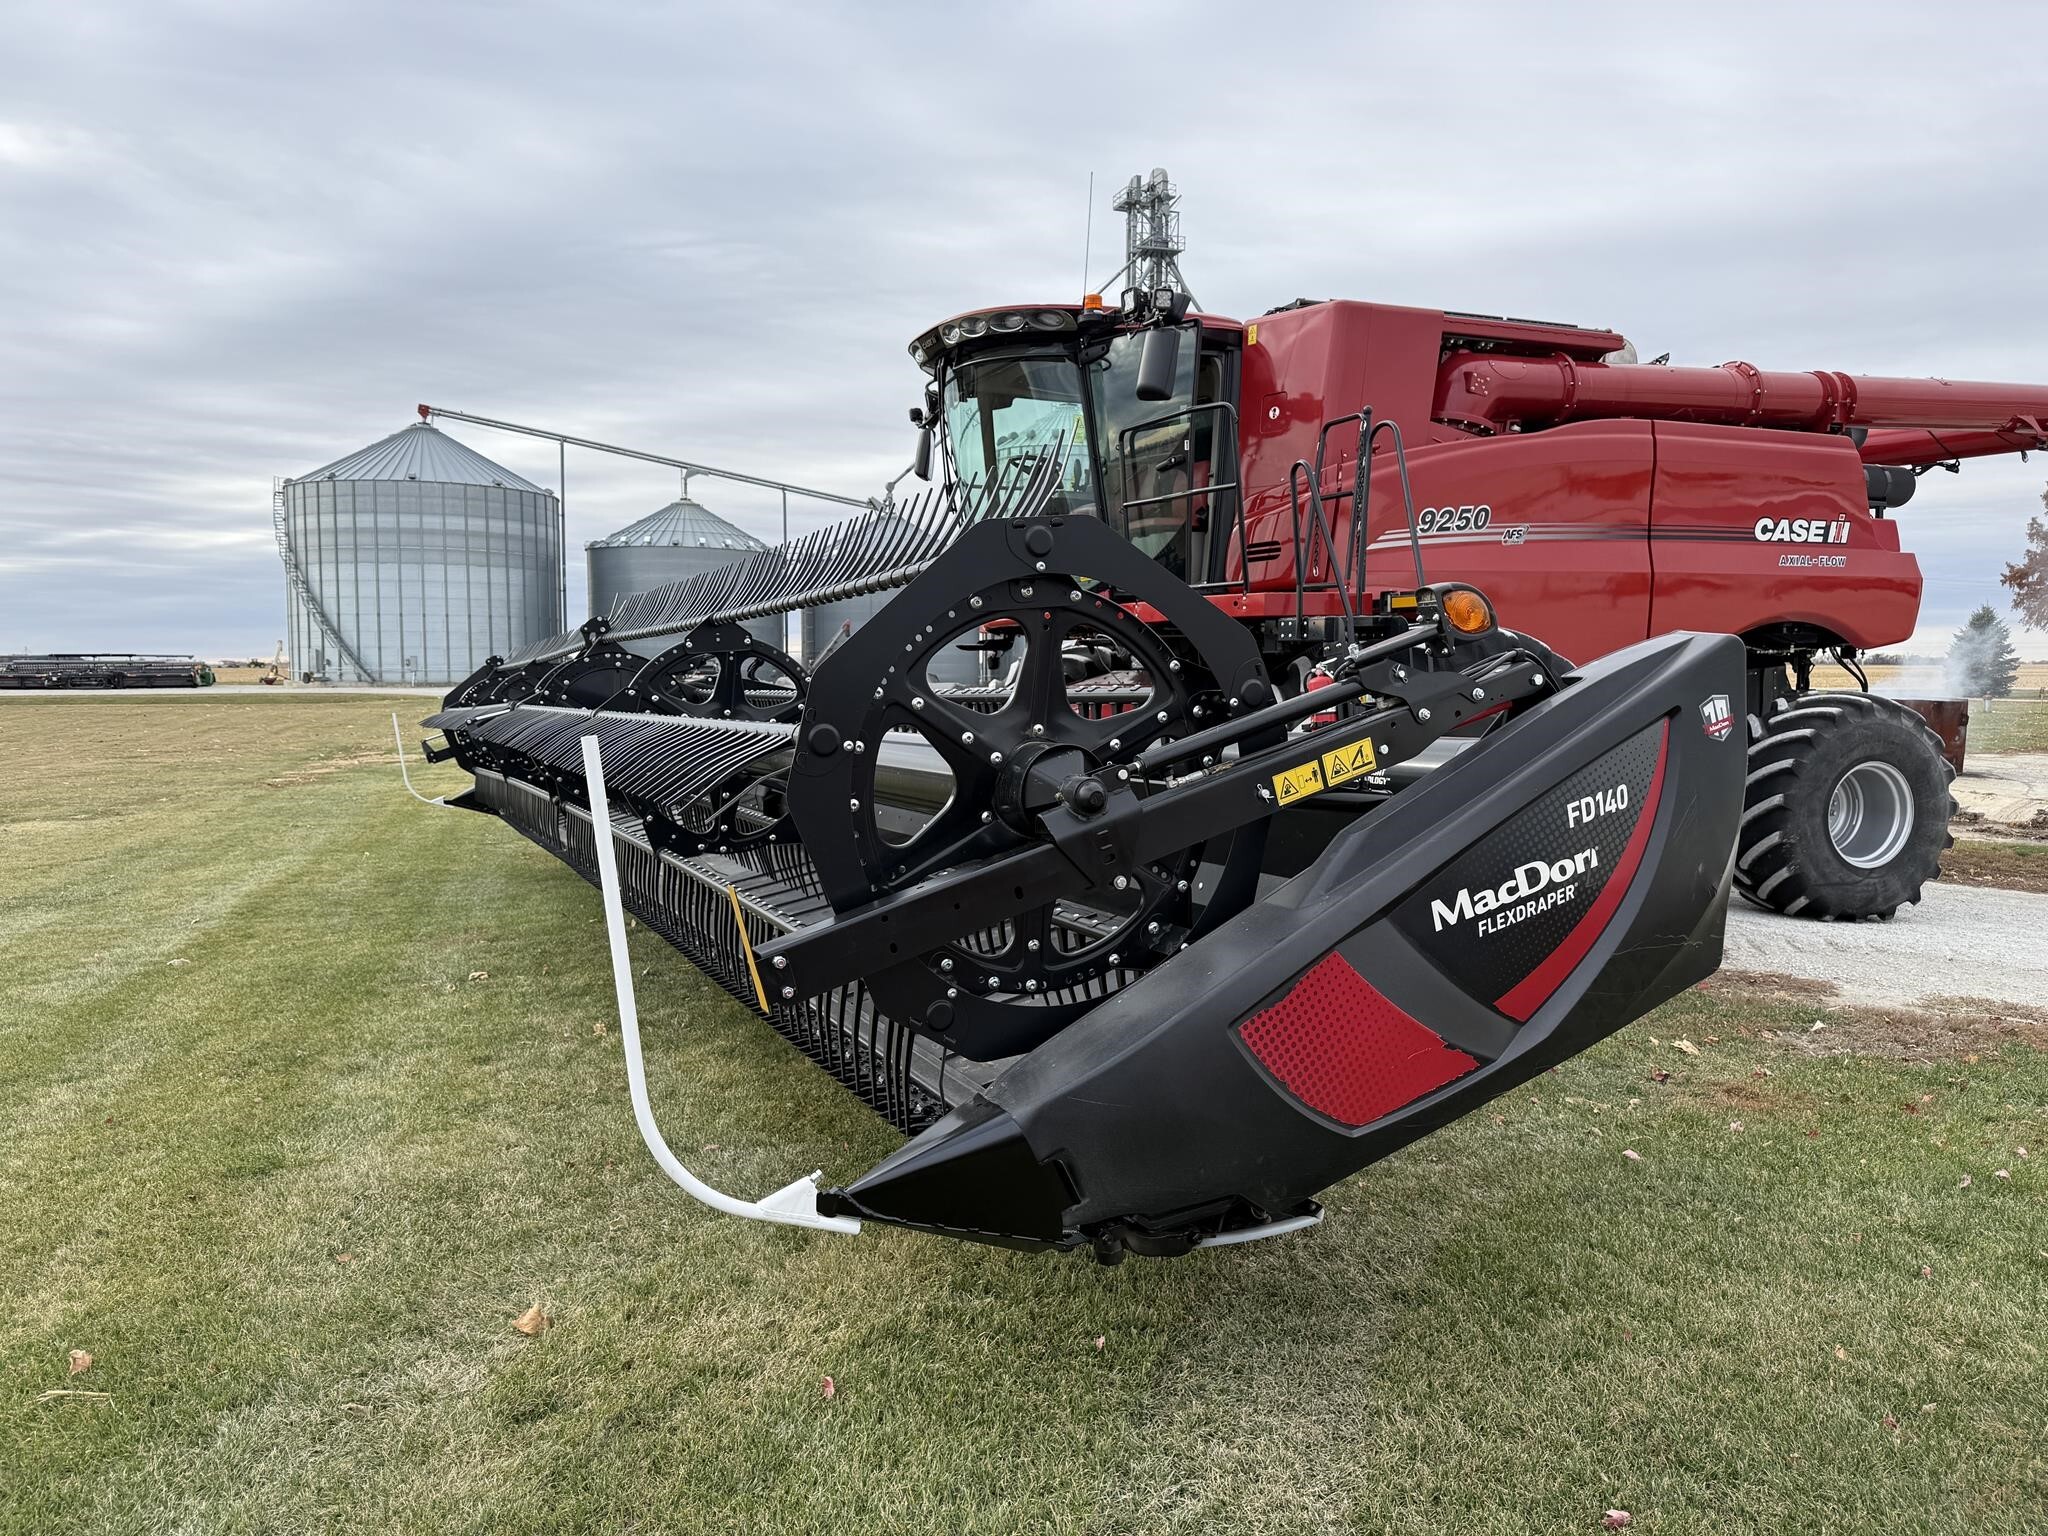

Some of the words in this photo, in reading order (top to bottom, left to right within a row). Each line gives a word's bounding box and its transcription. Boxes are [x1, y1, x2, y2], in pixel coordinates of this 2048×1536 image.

[1417, 505, 1491, 535] 9250
[1502, 528, 1523, 540] AFS
[1754, 517, 1826, 543] CASE
[1779, 554, 1846, 568] AXIAL-FLOW
[1567, 784, 1629, 829] FD140
[1431, 847, 1599, 932] MacDon
[1478, 884, 1575, 938] FLEXDRAPER
